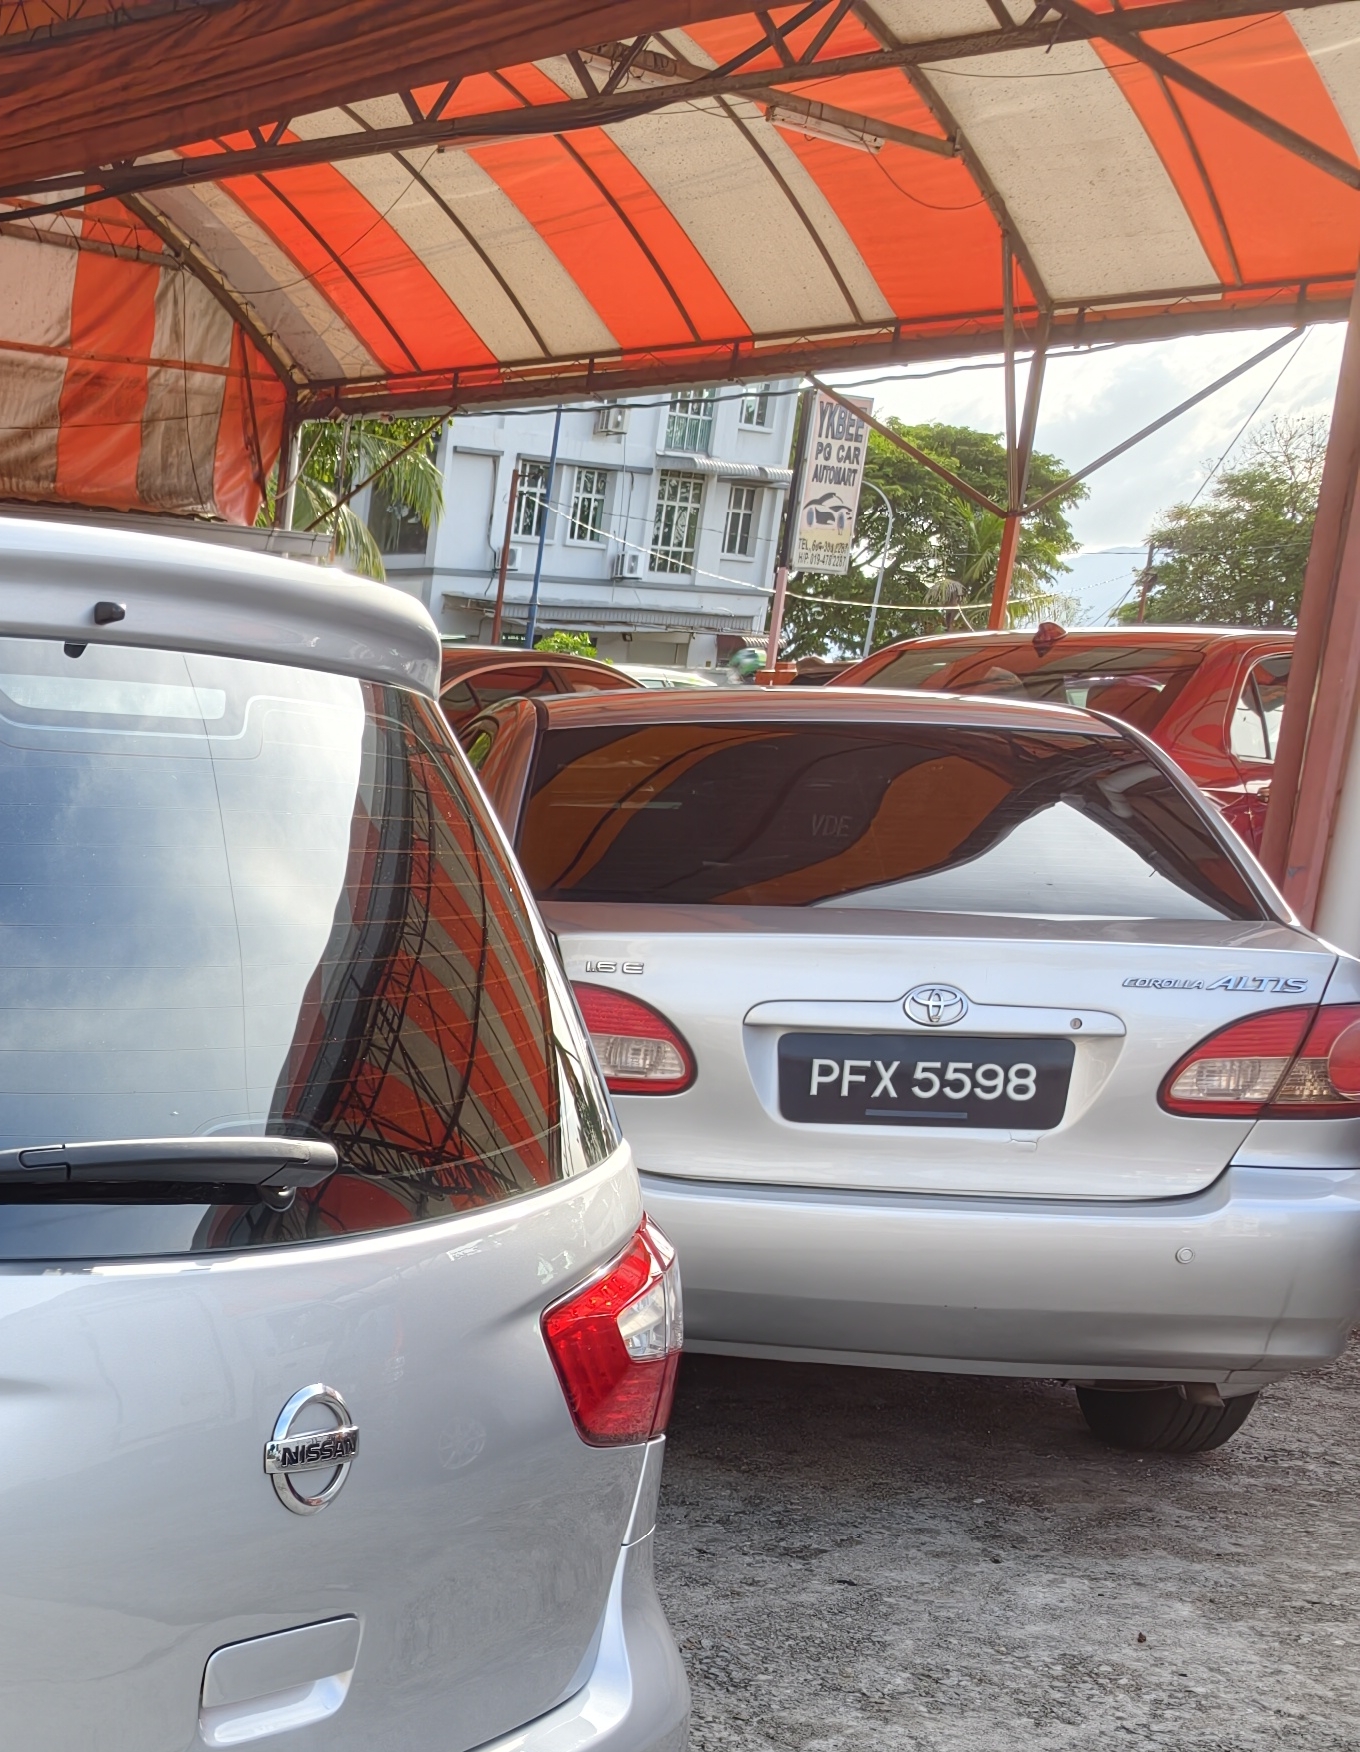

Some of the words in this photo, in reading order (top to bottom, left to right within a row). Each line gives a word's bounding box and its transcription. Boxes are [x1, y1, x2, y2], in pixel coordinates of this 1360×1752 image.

[818, 401, 867, 443] YKBEE
[836, 444, 861, 465] CAR
[812, 464, 858, 487] AUTOMART
[622, 962, 644, 974] E
[1122, 977, 1204, 990] COROLLA
[1206, 975, 1308, 993] ALTIS
[809, 1058, 901, 1098] PFX
[911, 1061, 1037, 1101] 5598
[281, 1436, 357, 1467] NISSAN
